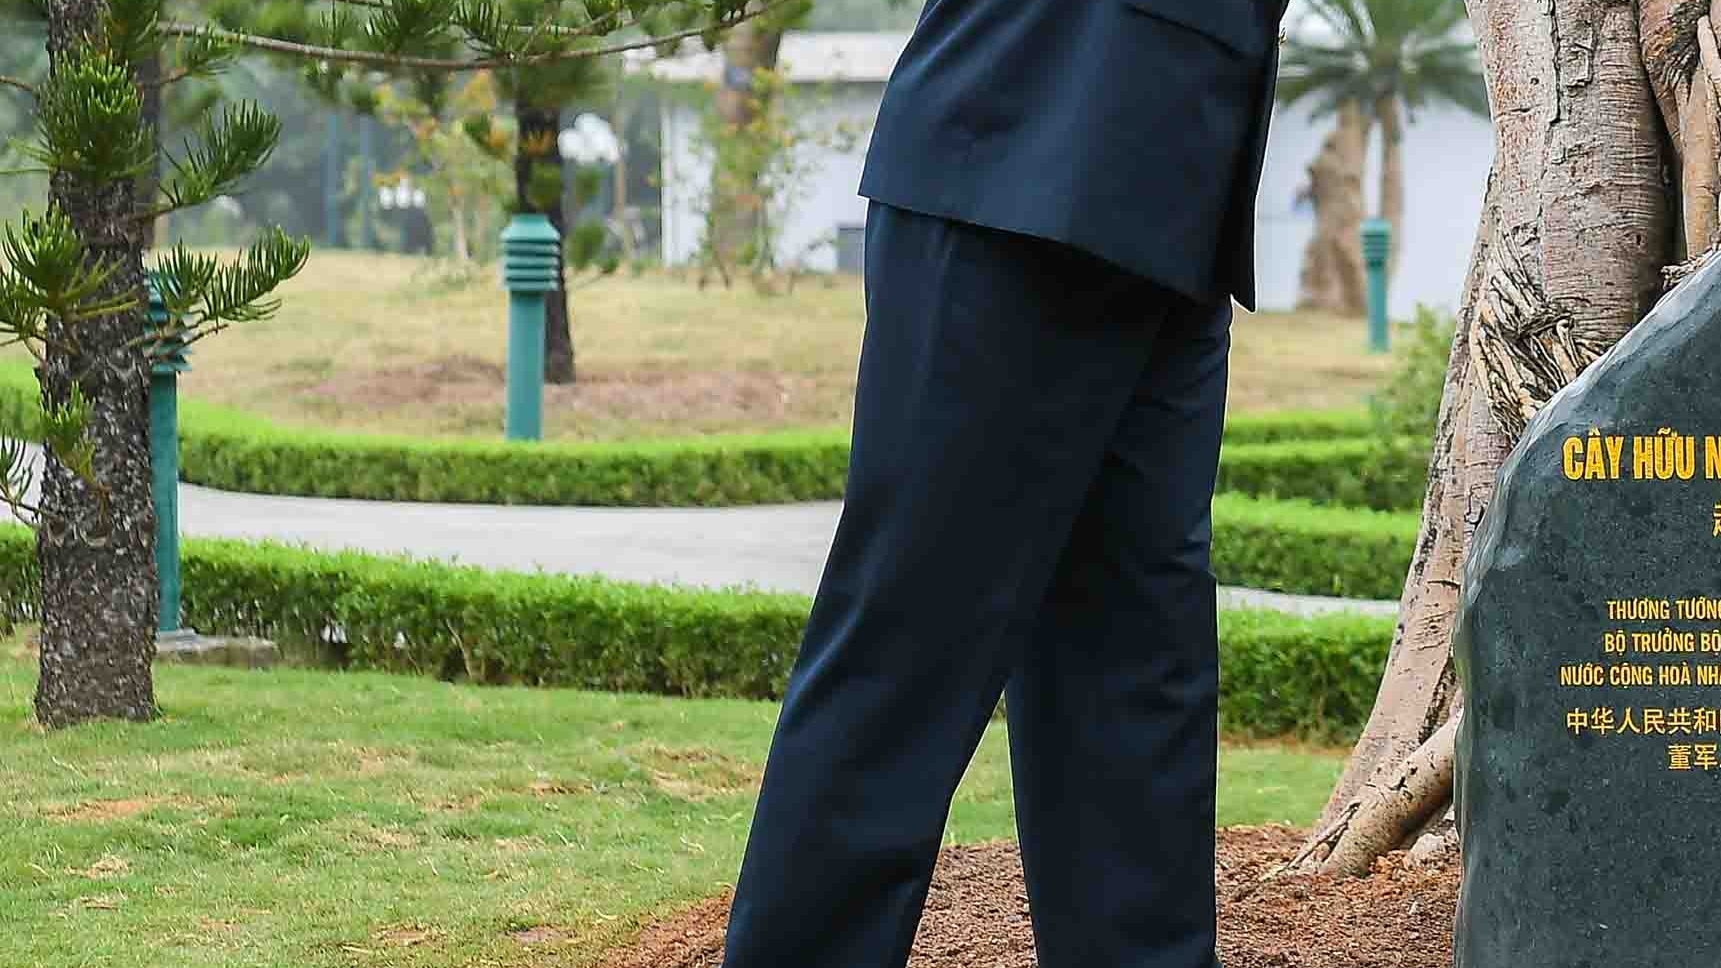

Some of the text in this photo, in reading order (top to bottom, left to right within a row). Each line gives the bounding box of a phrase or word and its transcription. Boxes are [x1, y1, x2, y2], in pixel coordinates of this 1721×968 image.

[1562, 427, 1625, 480] CÂY
[1632, 427, 1696, 480] HỮU
[1608, 598, 1670, 622] THƯỢNG
[1604, 631, 1626, 656] BỘ
[1631, 627, 1695, 652] TRƯỞNG
[1700, 630, 1721, 655] BỘ
[1560, 664, 1605, 685] NƯỚC
[1609, 663, 1653, 689] CỘNG
[1658, 663, 1691, 685] HOÀ
